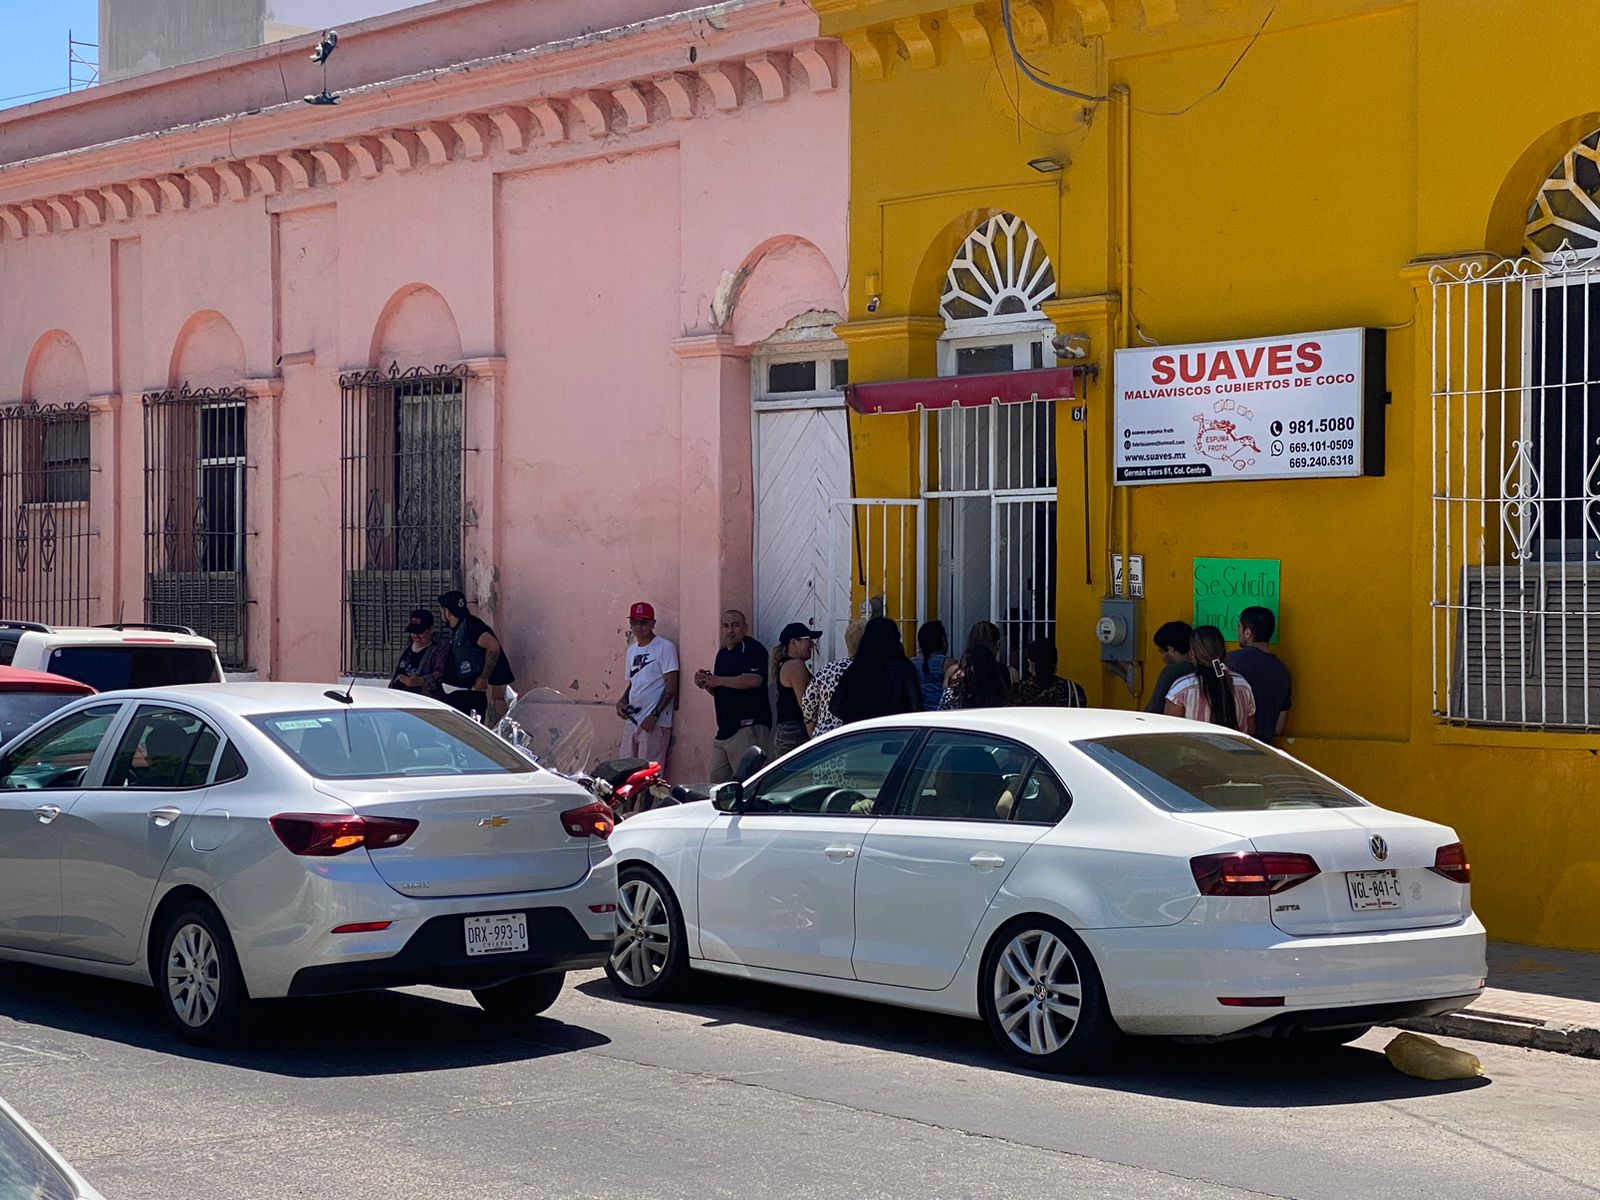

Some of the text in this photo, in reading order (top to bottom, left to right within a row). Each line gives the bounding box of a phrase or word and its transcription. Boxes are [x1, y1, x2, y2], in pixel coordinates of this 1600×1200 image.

[1151, 341, 1322, 385] SUAVES
[1124, 373, 1355, 401] MALVAVISCOS CUBIERTOS DE COCO
[1288, 417, 1355, 435] 981.5080
[1205, 435, 1229, 444] ESPUMA
[1289, 439, 1354, 454] 669.101-0509
[1208, 444, 1227, 452] FROTH
[1124, 452, 1187, 463] www.suaves.mx
[1289, 455, 1354, 469] 669.240.6318
[1146, 467, 1163, 476] Evers
[1186, 465, 1206, 474] Centro
[1194, 564, 1275, 598] Se Solicita
[1350, 879, 1401, 899] VGL-841-C
[468, 923, 526, 944] DRX-993-D
